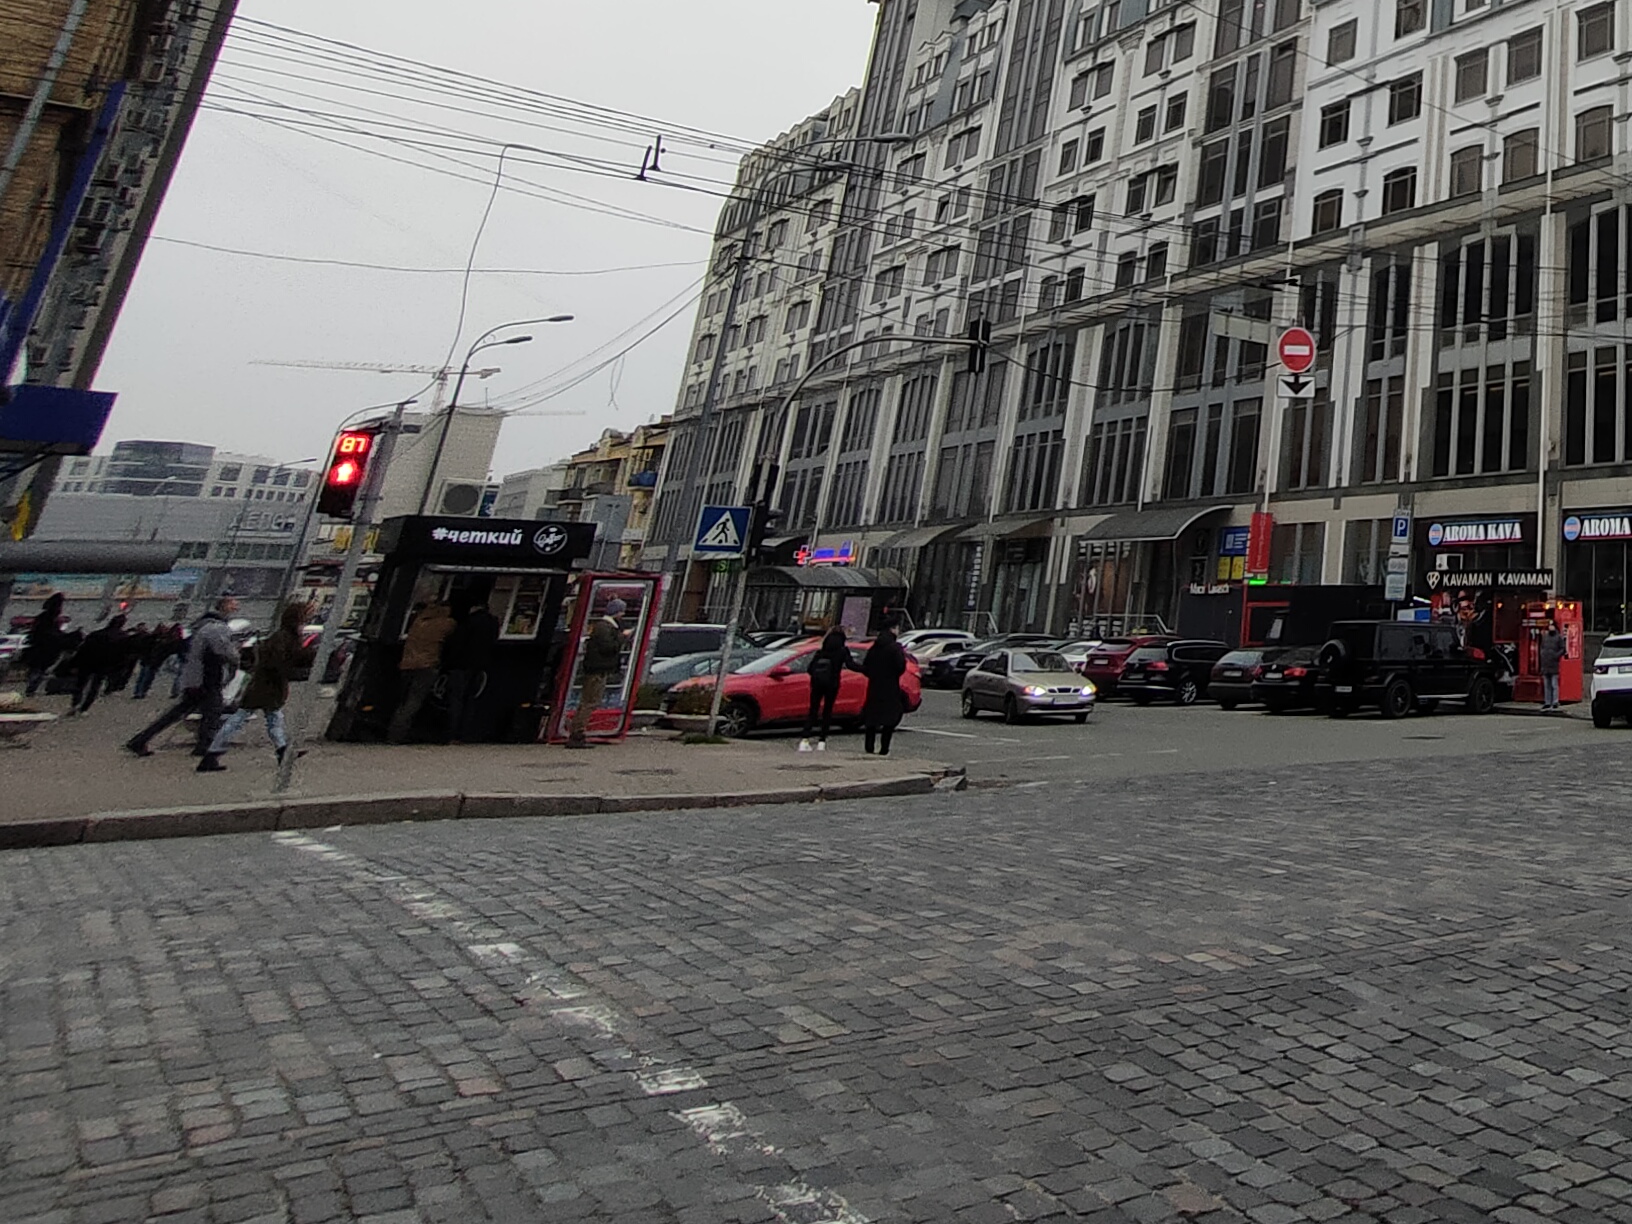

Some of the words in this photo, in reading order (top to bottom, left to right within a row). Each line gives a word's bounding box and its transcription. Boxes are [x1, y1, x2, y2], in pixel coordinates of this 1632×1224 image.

[1443, 524, 1485, 542] AROMA
[1487, 522, 1522, 540] KAVA
[1581, 517, 1631, 537] AROMA
[1443, 573, 1492, 587] KAVAMAN
[1498, 572, 1552, 586] KAVAMAN
